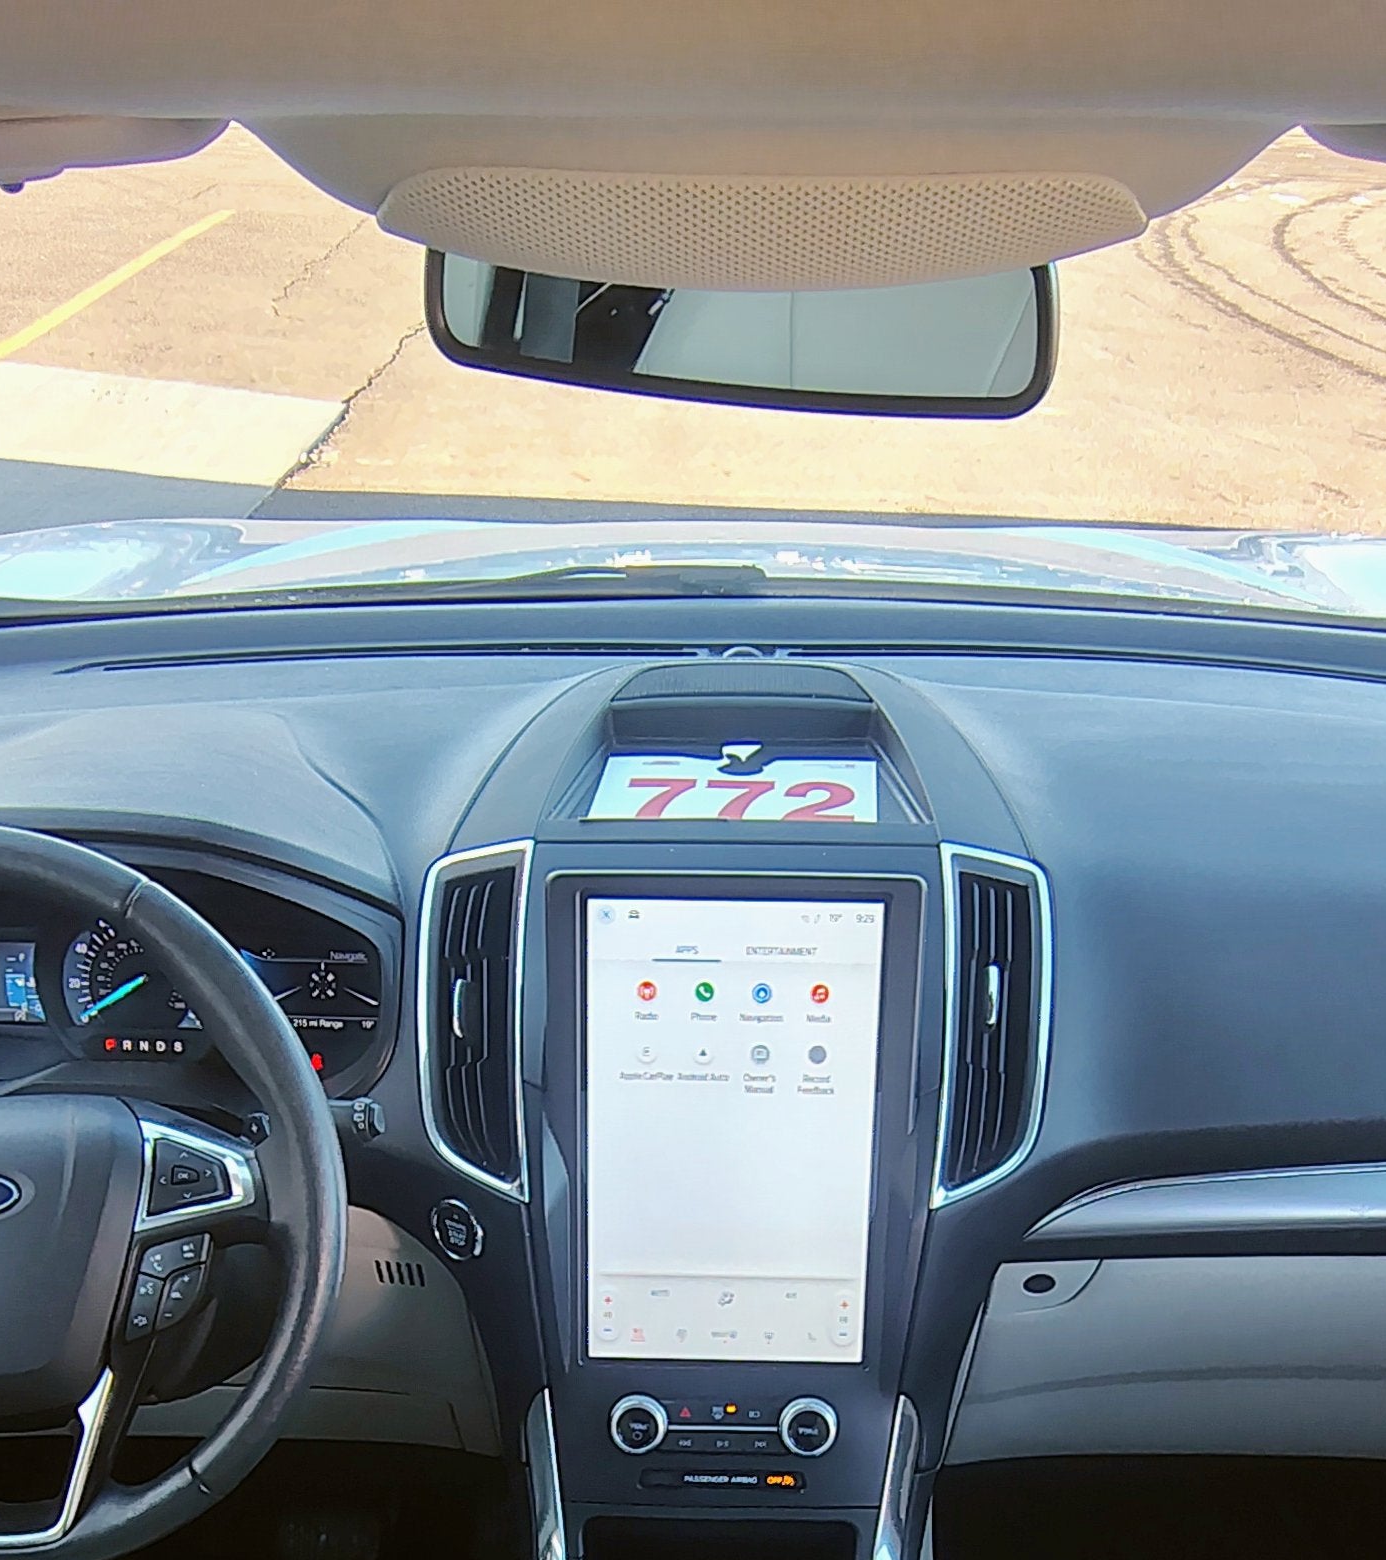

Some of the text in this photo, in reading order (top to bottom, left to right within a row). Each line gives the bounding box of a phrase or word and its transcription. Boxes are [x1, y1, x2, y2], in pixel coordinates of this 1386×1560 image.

[628, 778, 855, 822] 772
[293, 1019, 308, 1028] 215
[319, 1020, 344, 1030] Range
[105, 1038, 183, 1052] P R N D S
